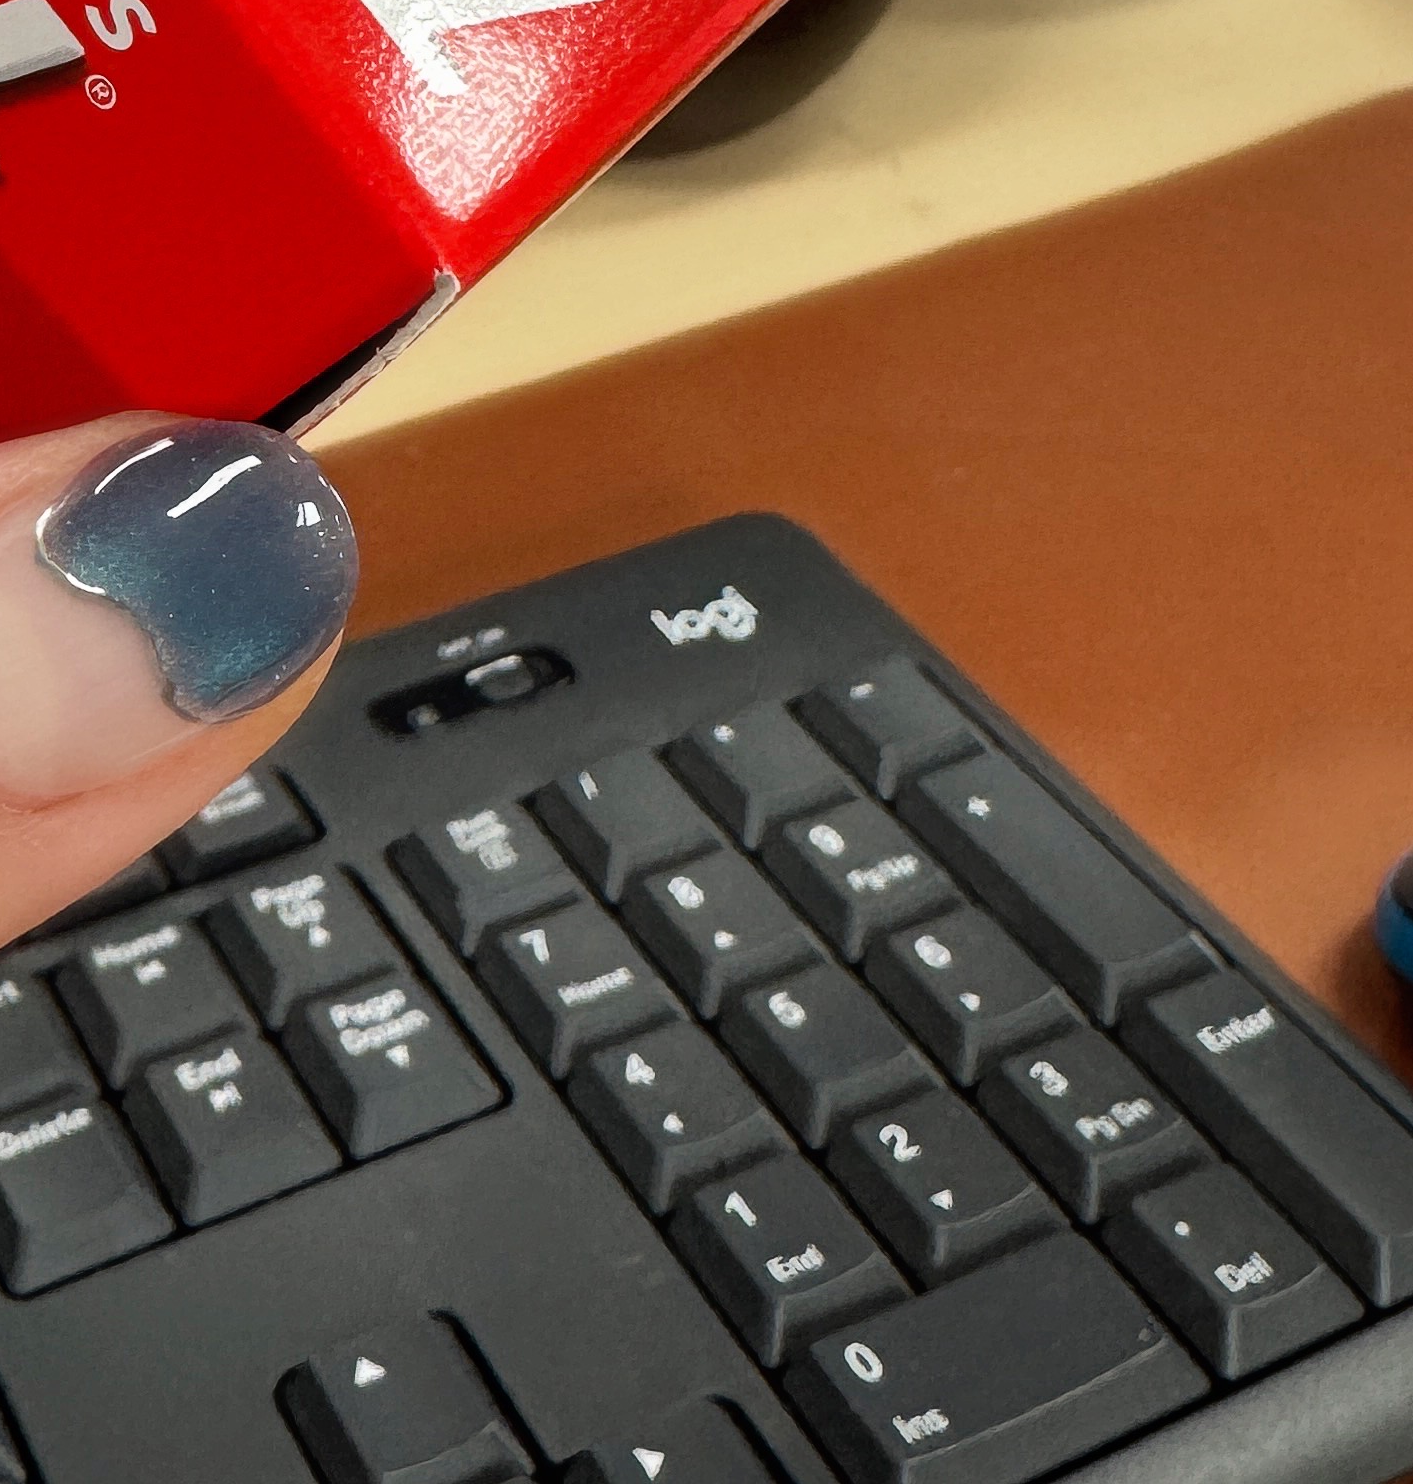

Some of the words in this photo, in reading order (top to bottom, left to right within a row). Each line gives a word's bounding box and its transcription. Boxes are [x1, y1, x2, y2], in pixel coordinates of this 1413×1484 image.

[519, 929, 549, 964] 7
[626, 1053, 655, 1085] 4
[1030, 1062, 1068, 1096] 3
[879, 1124, 921, 1162] 2
[725, 1192, 756, 1226] 1
[845, 1343, 882, 1382] 0
